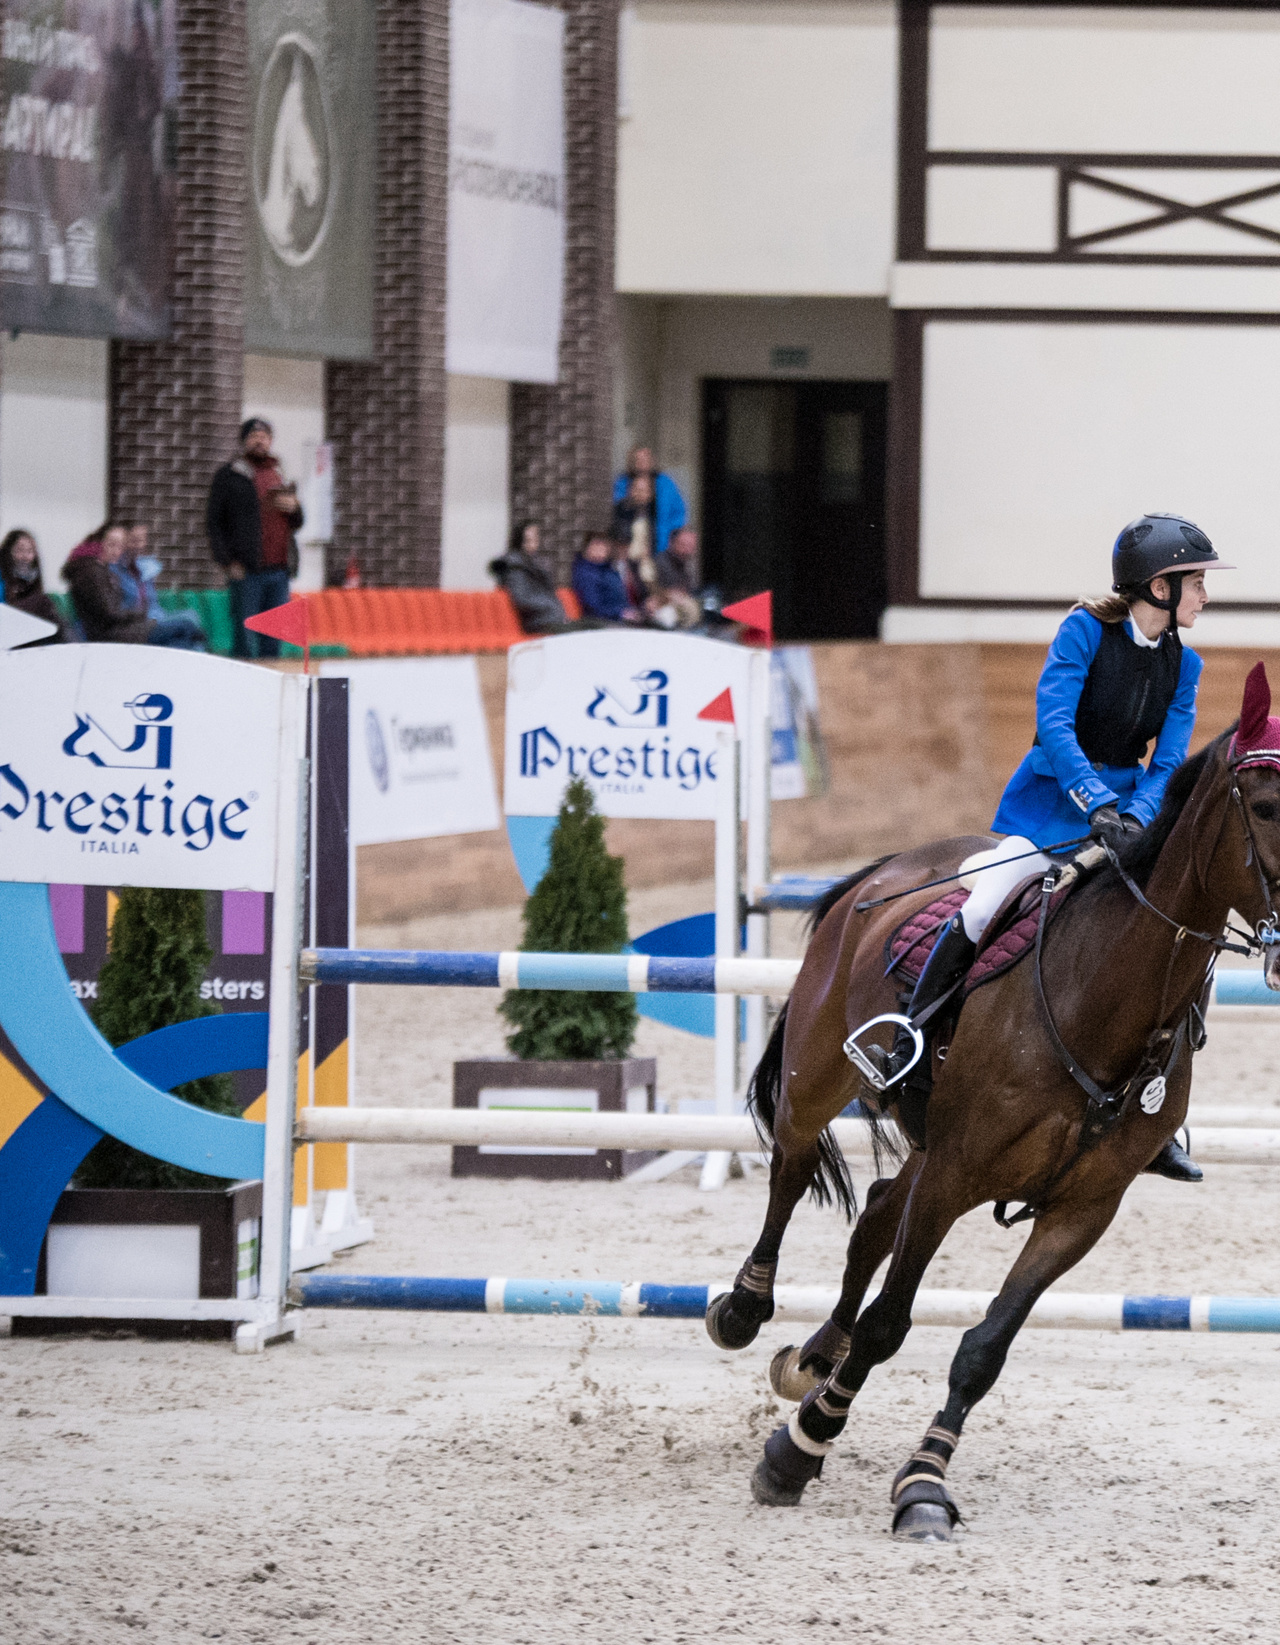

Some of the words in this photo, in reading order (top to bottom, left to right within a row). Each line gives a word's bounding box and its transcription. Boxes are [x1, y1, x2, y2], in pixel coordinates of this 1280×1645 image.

[600, 783, 645, 794] ITALIA
[80, 839, 140, 855] ITALIA
[199, 976, 266, 1000] sters
